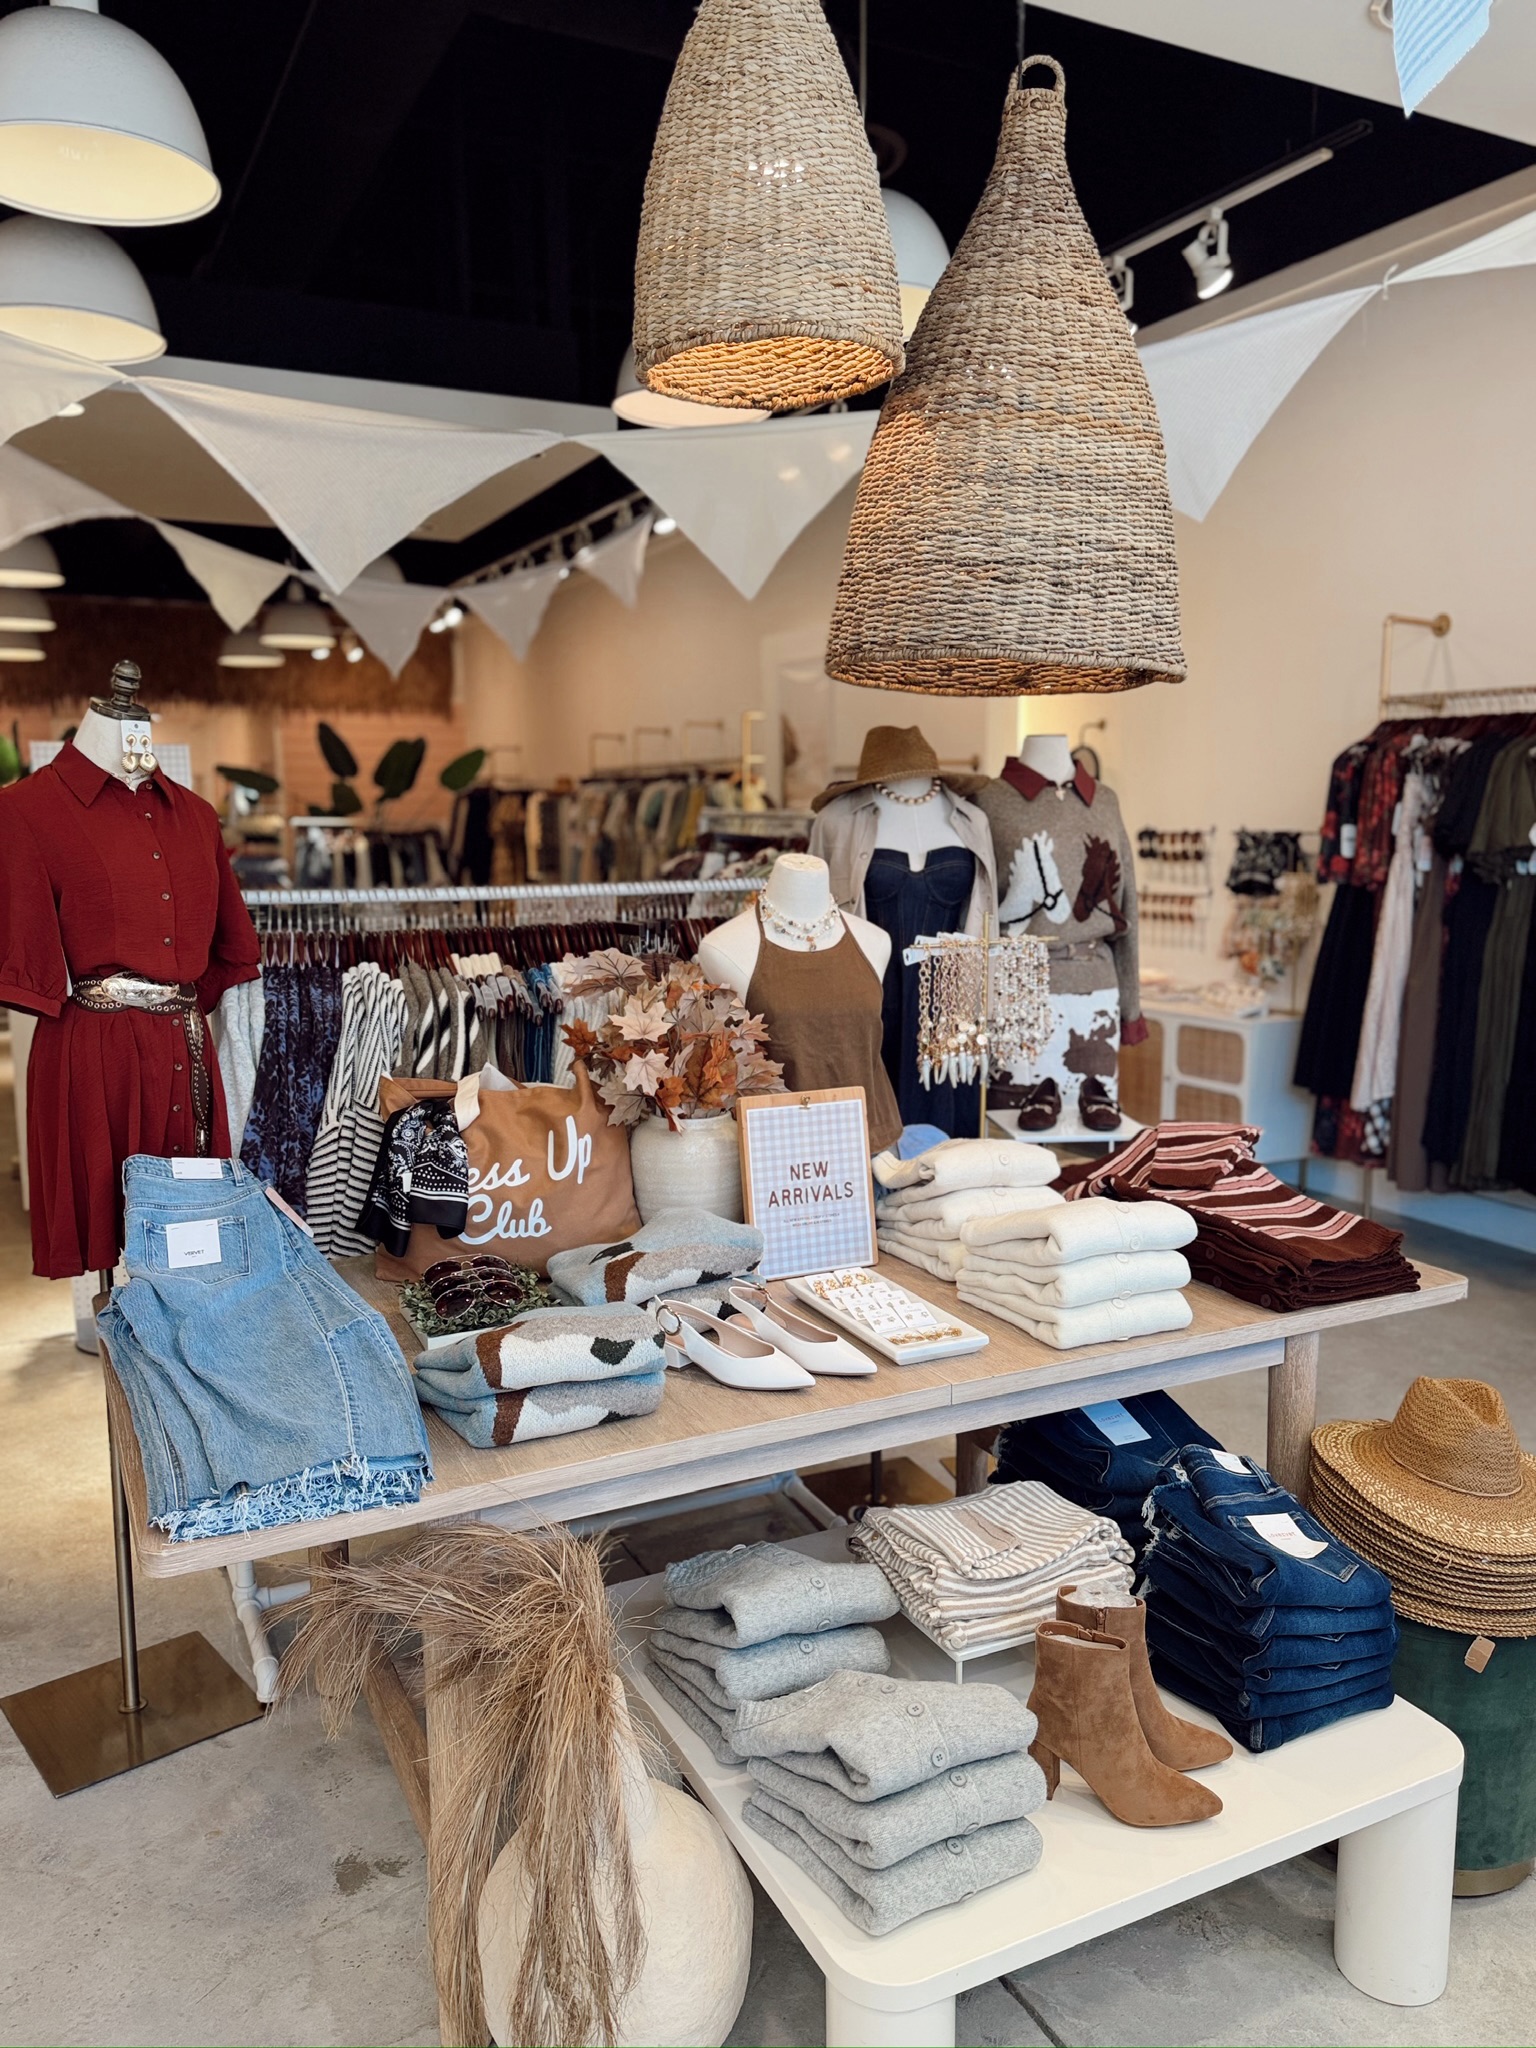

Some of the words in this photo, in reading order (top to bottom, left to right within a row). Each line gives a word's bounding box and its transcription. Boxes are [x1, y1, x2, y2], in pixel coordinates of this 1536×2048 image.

[468, 1158, 531, 1194] ess
[547, 1115, 592, 1185] Up
[790, 1160, 828, 1181] NEW
[768, 1181, 854, 1208] ARRIVALS
[458, 1193, 553, 1246] Club
